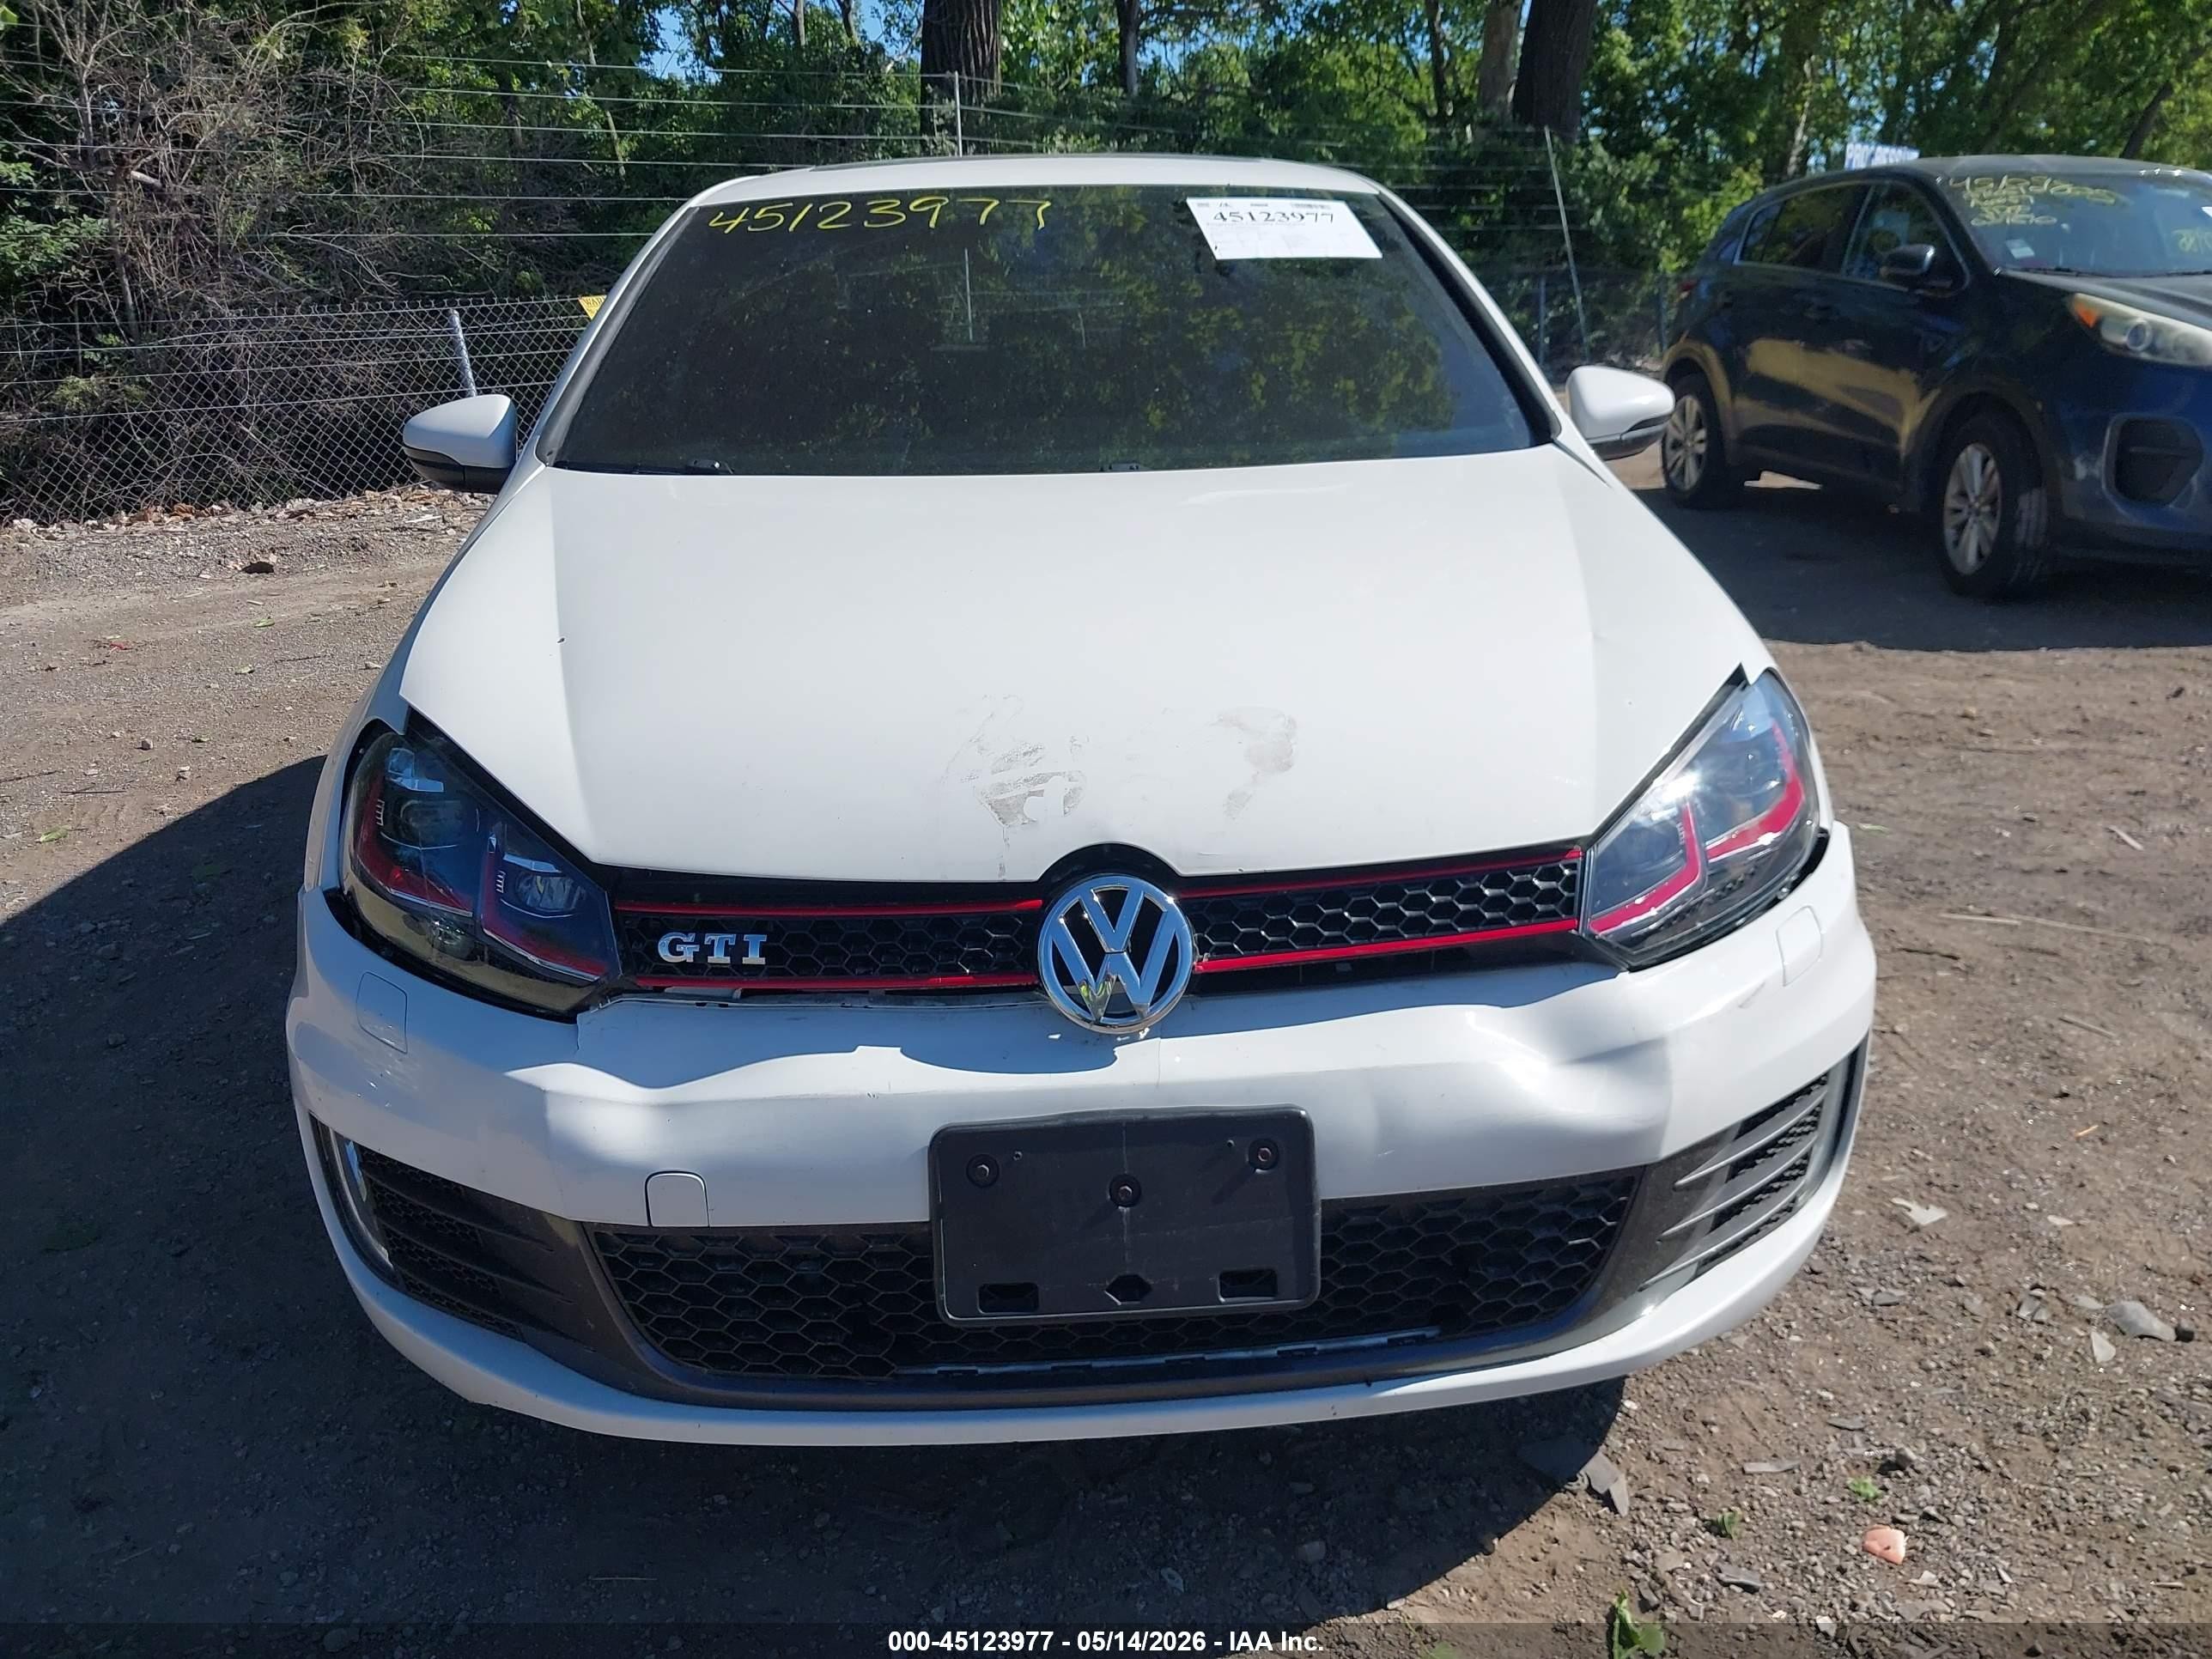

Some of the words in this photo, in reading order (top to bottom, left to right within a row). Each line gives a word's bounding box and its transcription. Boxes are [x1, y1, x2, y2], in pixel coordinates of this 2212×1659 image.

[708, 197, 1052, 234] 45123977
[1212, 211, 1334, 223] 45123977
[658, 932, 767, 964] GTI
